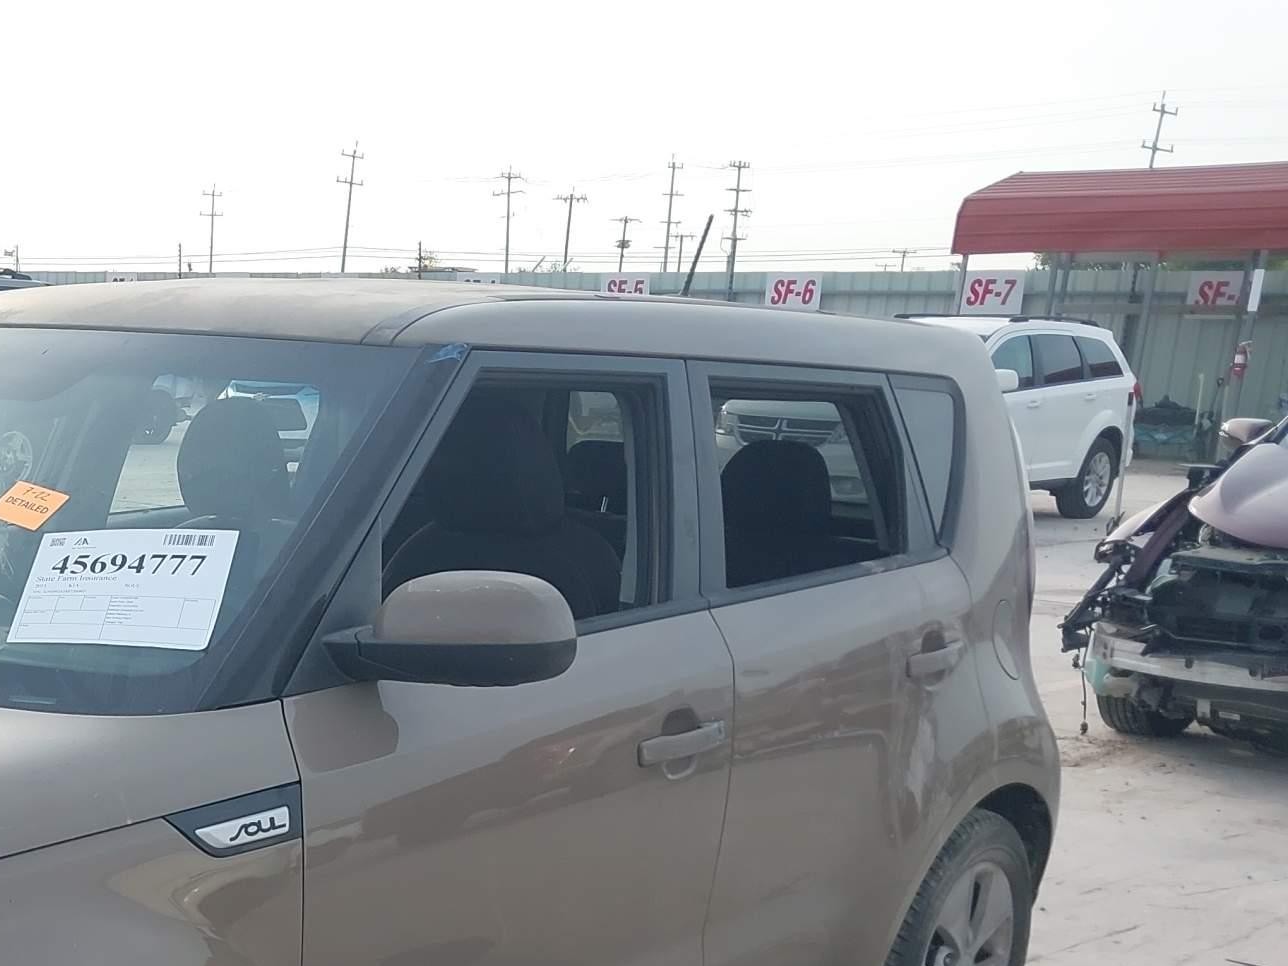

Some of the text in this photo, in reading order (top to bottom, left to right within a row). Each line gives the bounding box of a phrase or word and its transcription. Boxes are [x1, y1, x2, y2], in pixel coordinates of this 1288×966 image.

[771, 279, 816, 305] SF-6
[966, 278, 1017, 306] SF-7
[1194, 280, 1240, 307] SF-
[5, 495, 49, 514] DETAILED
[52, 553, 208, 576] 45694777
[229, 817, 286, 842] SOUL
